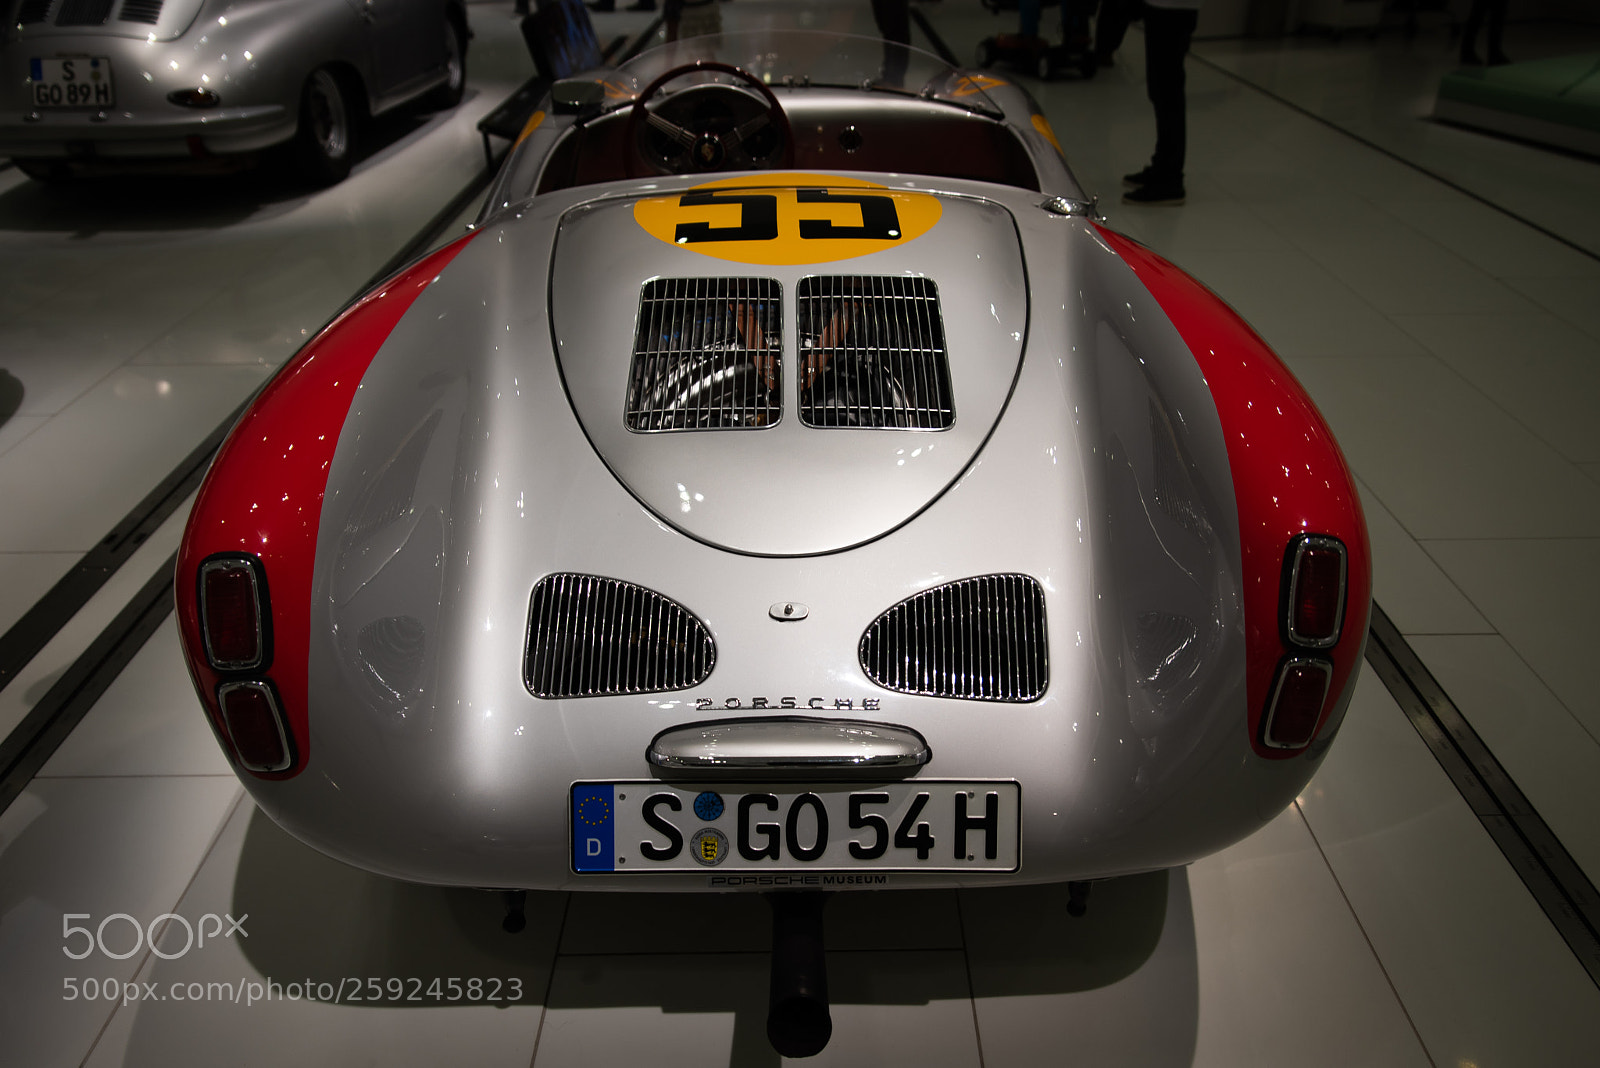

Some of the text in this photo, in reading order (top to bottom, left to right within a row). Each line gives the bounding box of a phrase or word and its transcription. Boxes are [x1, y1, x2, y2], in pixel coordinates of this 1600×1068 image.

[62, 60, 75, 81] S
[36, 83, 109, 104] GO 89 H
[696, 697, 880, 711] PORSCHE
[639, 792, 684, 862] S
[736, 792, 829, 862] GO
[848, 792, 935, 861] 54
[953, 791, 999, 860] H
[585, 837, 602, 857] D
[711, 875, 887, 886] PORSCHE MUSEUM
